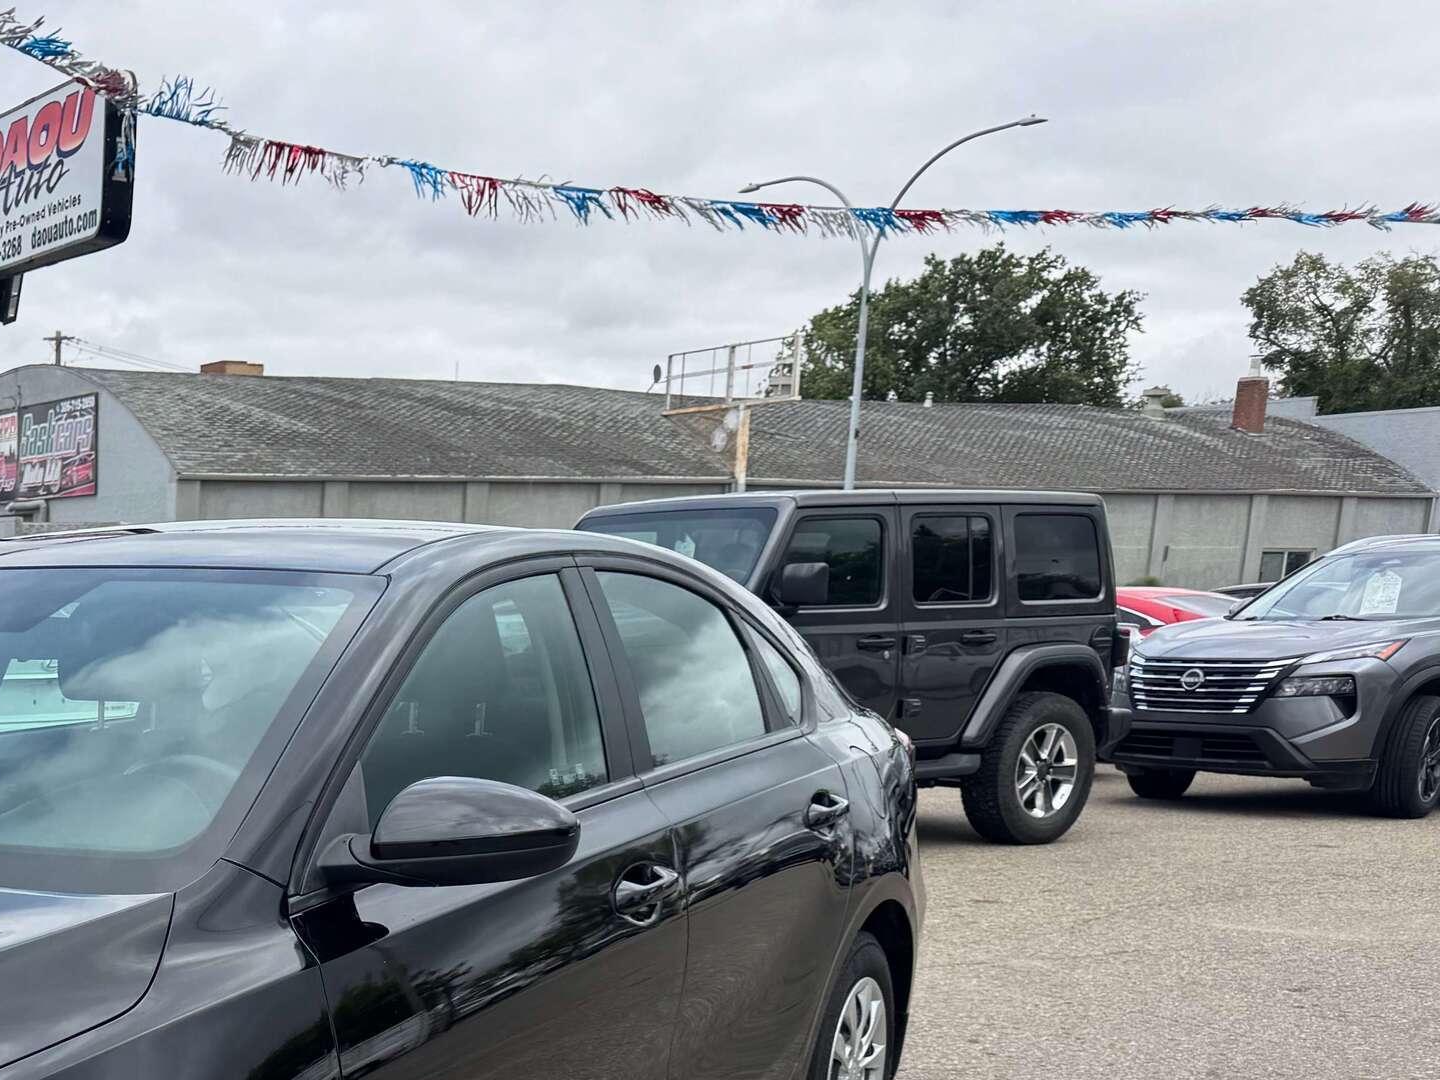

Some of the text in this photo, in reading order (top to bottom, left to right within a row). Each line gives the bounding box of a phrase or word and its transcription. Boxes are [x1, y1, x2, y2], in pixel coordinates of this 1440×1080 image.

[5, 205, 46, 233] Pre-Owned
[48, 194, 81, 217] Vehicles
[31, 209, 97, 250] daouauto.com
